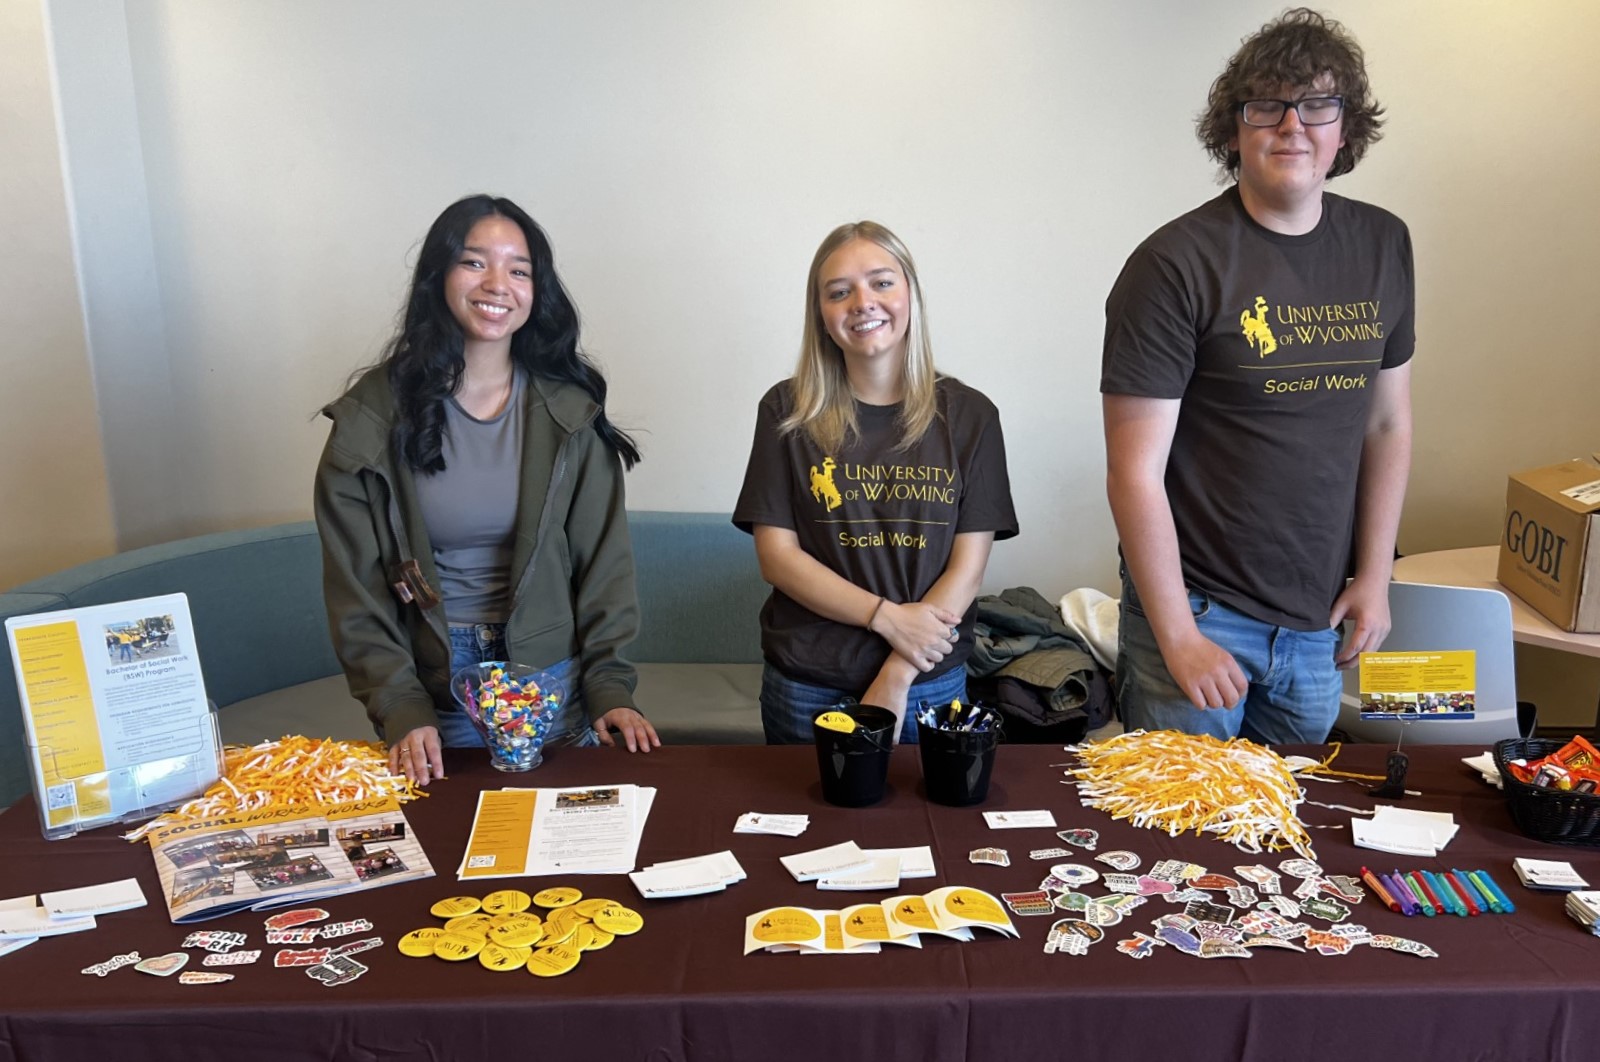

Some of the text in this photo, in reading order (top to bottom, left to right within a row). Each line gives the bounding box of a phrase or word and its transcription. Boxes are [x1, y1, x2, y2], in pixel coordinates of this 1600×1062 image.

[1276, 300, 1380, 325] UNIVERSITY
[1279, 322, 1384, 346] OF WYOMING
[1263, 373, 1367, 393] Social Work
[845, 463, 956, 485] UNIVERSITY
[845, 482, 956, 504] OF WYOMING
[838, 531, 926, 549] Social Work
[1506, 510, 1567, 582] GOBI
[106, 654, 188, 675] Bachelor of Social Work
[123, 666, 176, 681] (BSW) Program
[326, 799, 389, 816] WORKS
[158, 806, 311, 840] SOCIAL WORKS
